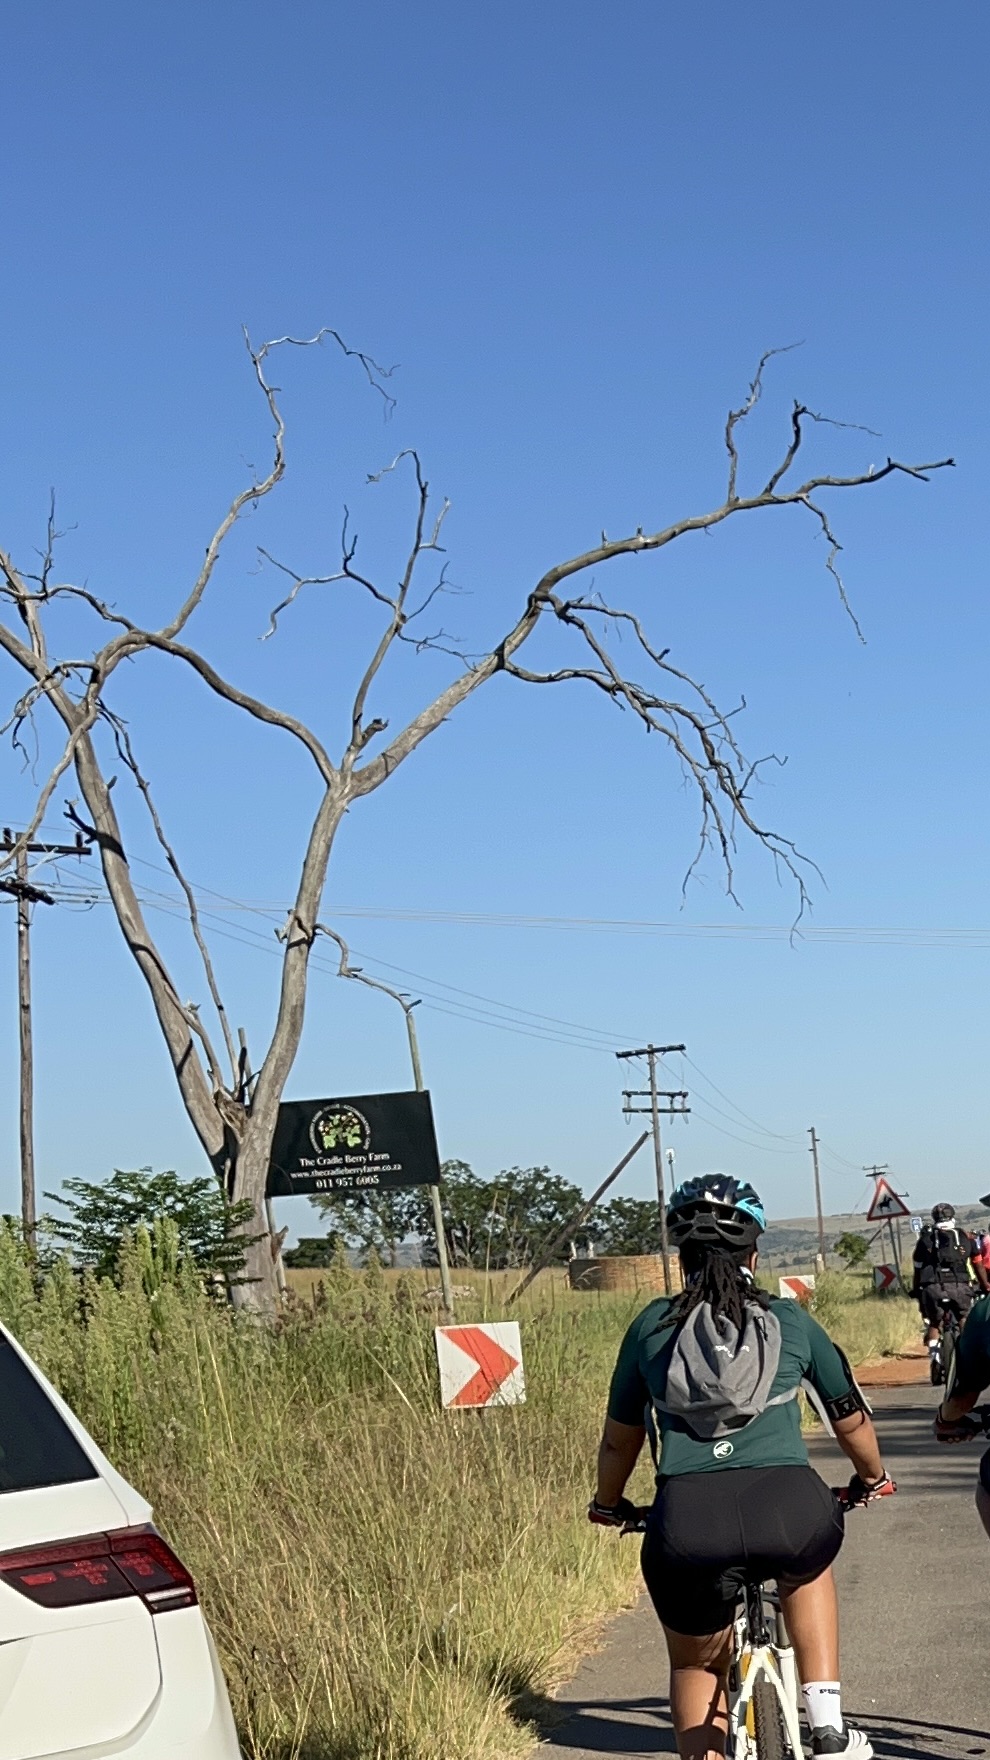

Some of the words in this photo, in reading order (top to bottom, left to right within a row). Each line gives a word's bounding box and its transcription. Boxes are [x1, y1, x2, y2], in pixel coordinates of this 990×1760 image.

[300, 1158, 315, 1167] The
[316, 1156, 343, 1166] Cradle
[344, 1154, 367, 1164] Berry
[368, 1152, 390, 1161] Farm
[316, 1179, 333, 1188] 011
[335, 1177, 353, 1187] 957
[355, 1175, 379, 1185] 6005
